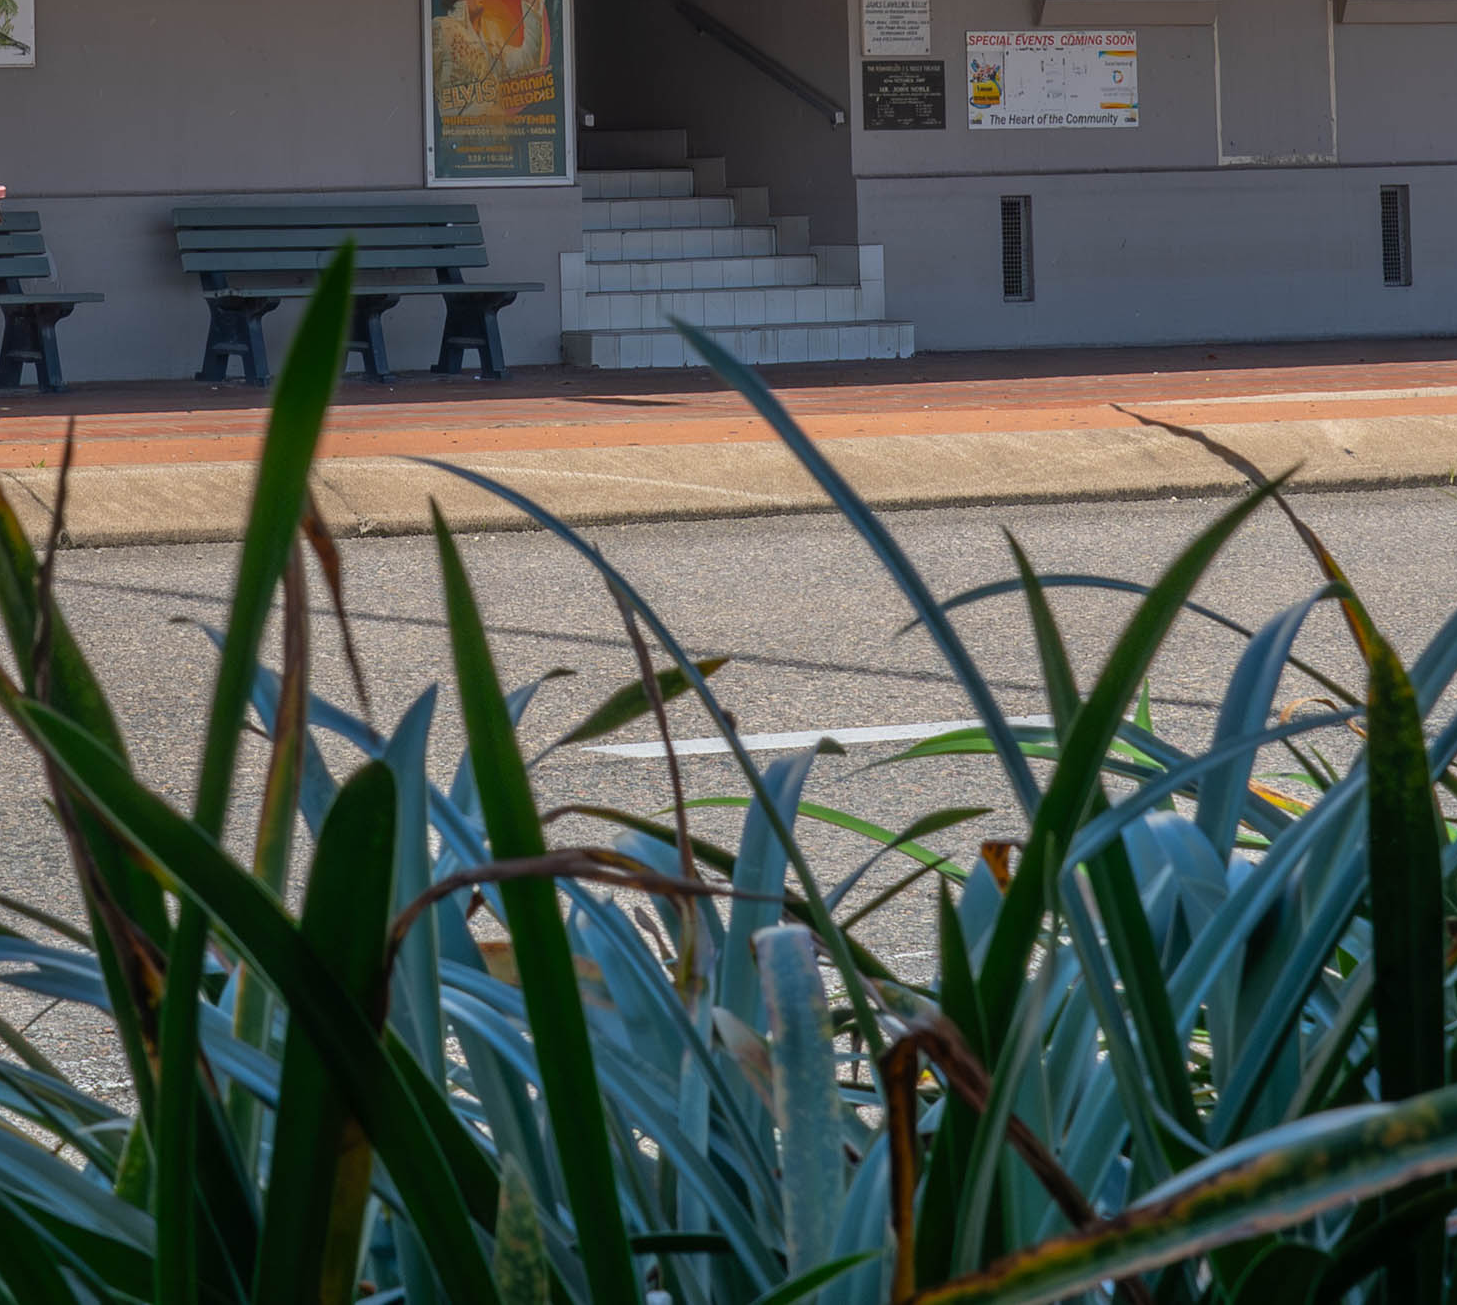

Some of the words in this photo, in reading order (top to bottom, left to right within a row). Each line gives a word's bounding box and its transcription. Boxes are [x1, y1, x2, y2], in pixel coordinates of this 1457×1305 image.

[968, 34, 1013, 47] SPECIAL
[1015, 34, 1055, 46] EVENTS
[1060, 34, 1103, 46] COMING
[1105, 34, 1135, 46] SOON
[442, 78, 496, 111] ELVIS
[499, 72, 555, 95] MORNING
[501, 85, 556, 109] MELODIES
[989, 113, 1006, 125] The
[1009, 113, 1035, 125] Heart
[1037, 112, 1047, 125] of
[1048, 113, 1064, 125] the
[1065, 112, 1119, 126] Community
